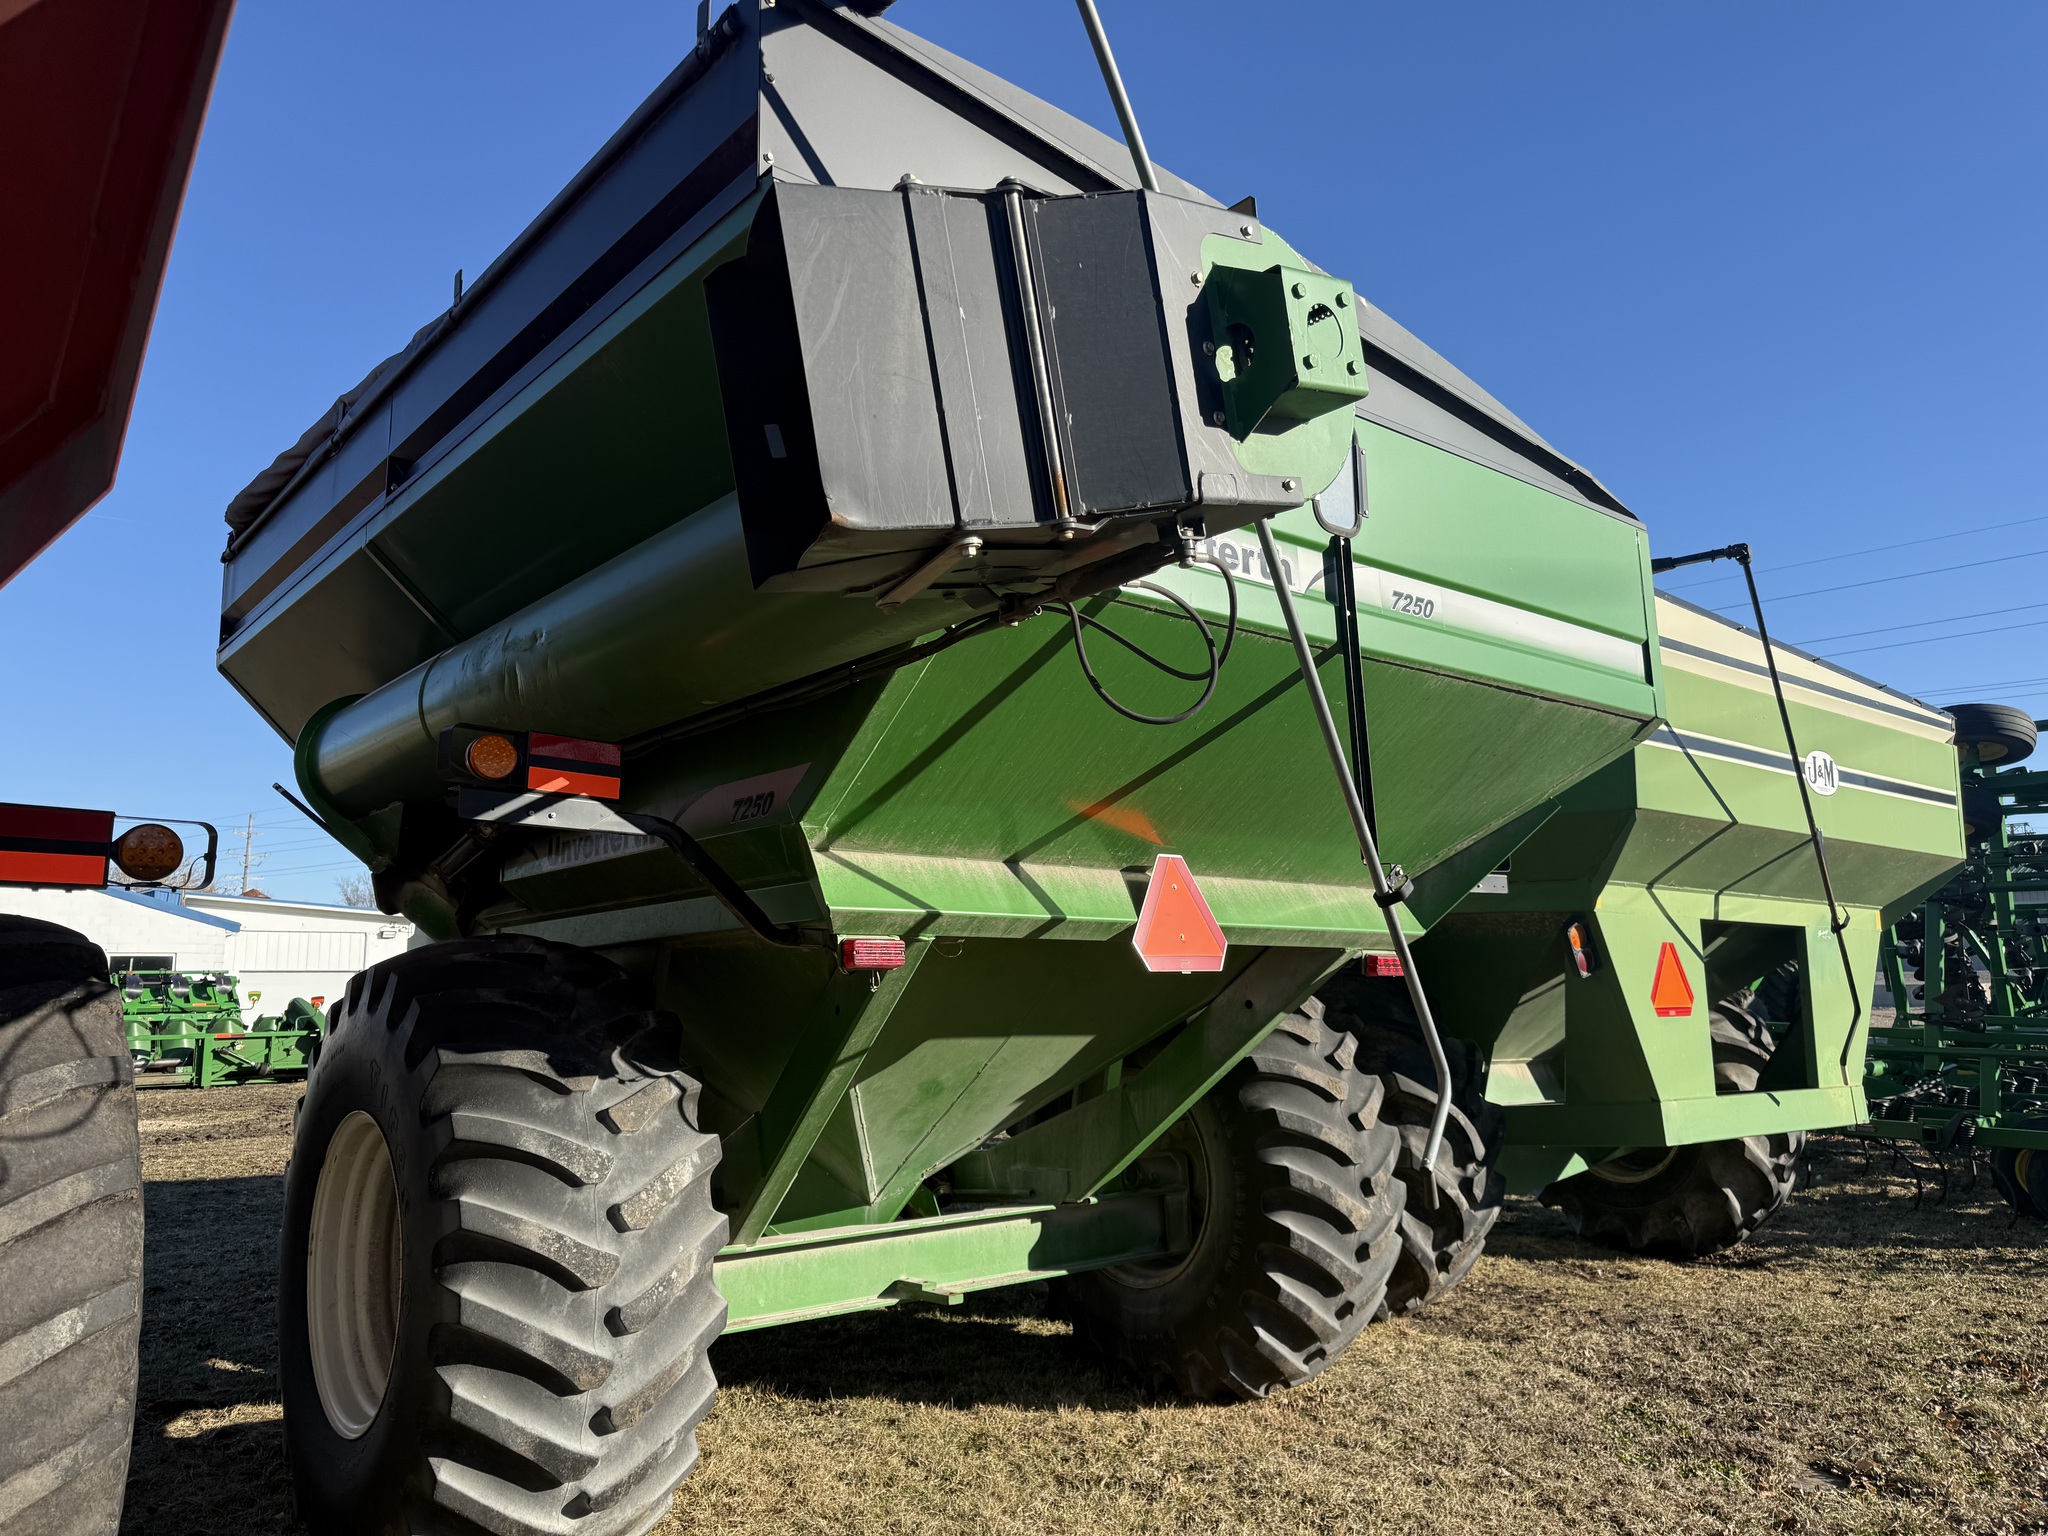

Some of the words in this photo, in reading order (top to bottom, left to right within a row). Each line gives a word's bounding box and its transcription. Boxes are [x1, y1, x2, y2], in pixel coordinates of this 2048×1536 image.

[1392, 589, 1434, 618] 7250
[1808, 755, 1835, 788] J&M
[731, 790, 775, 823] 7250
